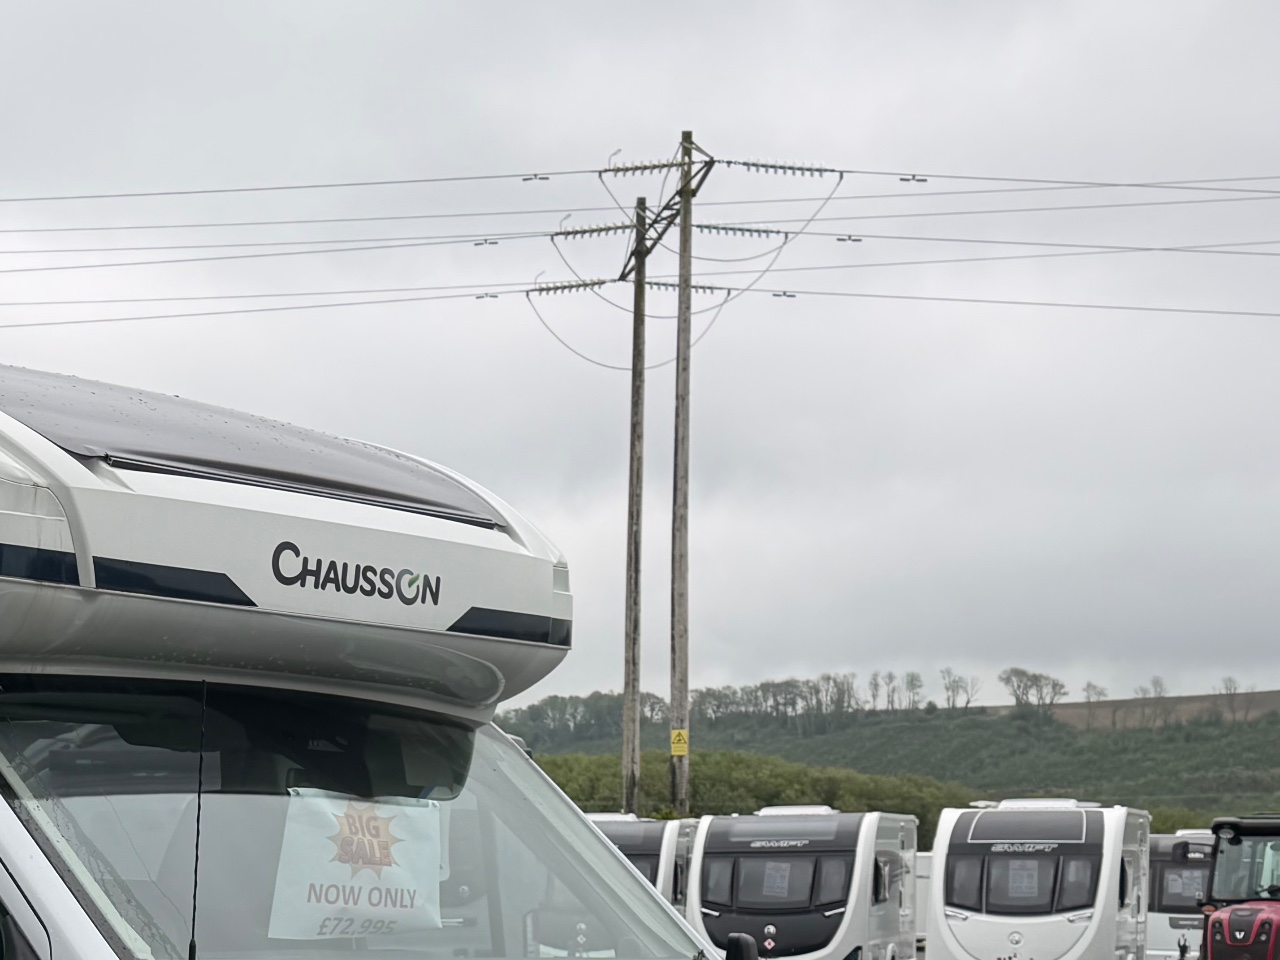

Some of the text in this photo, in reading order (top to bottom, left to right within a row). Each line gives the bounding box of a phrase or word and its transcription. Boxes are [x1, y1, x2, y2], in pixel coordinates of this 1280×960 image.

[272, 541, 441, 606] CHAUSSON
[345, 814, 381, 839] BIG
[339, 837, 392, 867] SALE
[991, 843, 1059, 853] SWIFT
[307, 883, 417, 909] NOW ONLY
[317, 917, 397, 936] £72,995
